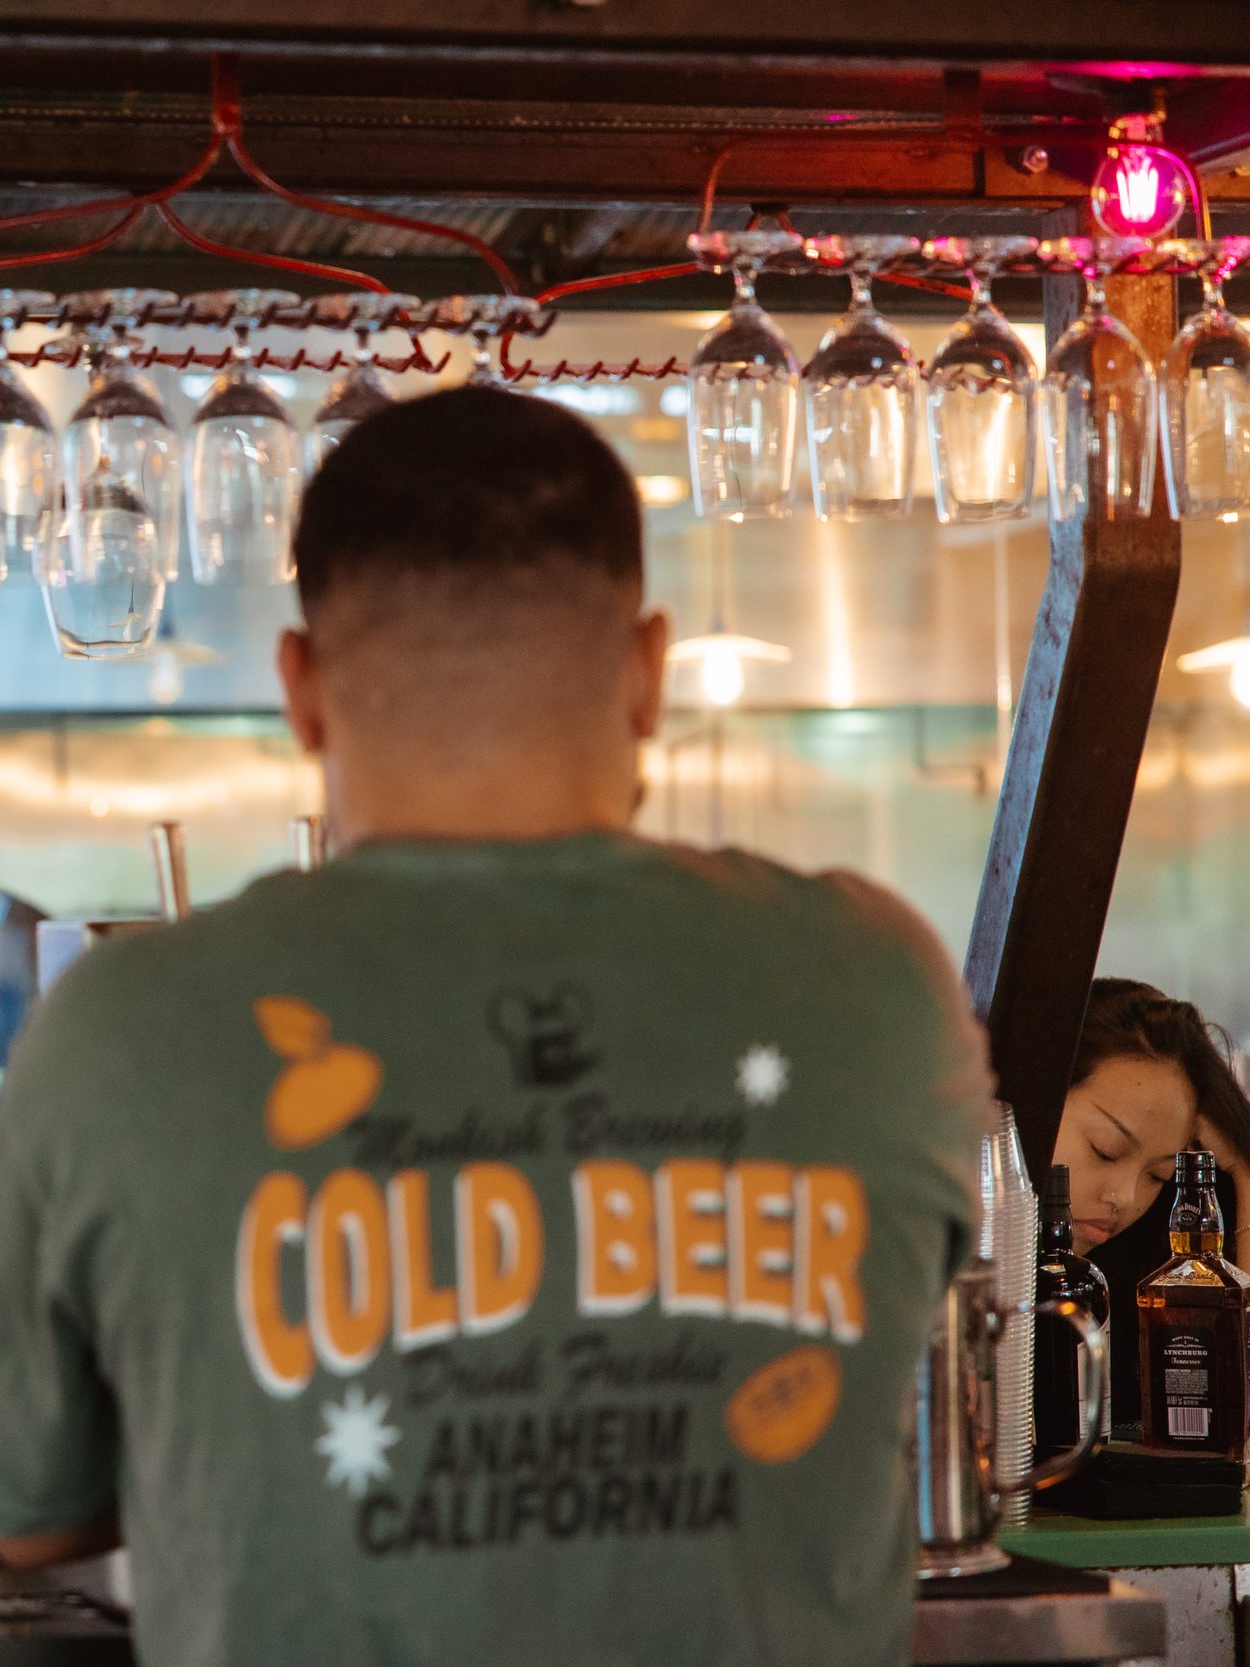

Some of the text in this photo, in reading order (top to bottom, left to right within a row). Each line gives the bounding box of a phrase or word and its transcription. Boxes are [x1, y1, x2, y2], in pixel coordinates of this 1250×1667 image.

[236, 1157, 868, 1398] COLD BEER
[1171, 1357, 1201, 1365] Tennessee
[424, 1401, 691, 1480] ANAHEIM
[355, 1464, 740, 1559] CALIFORNIA
